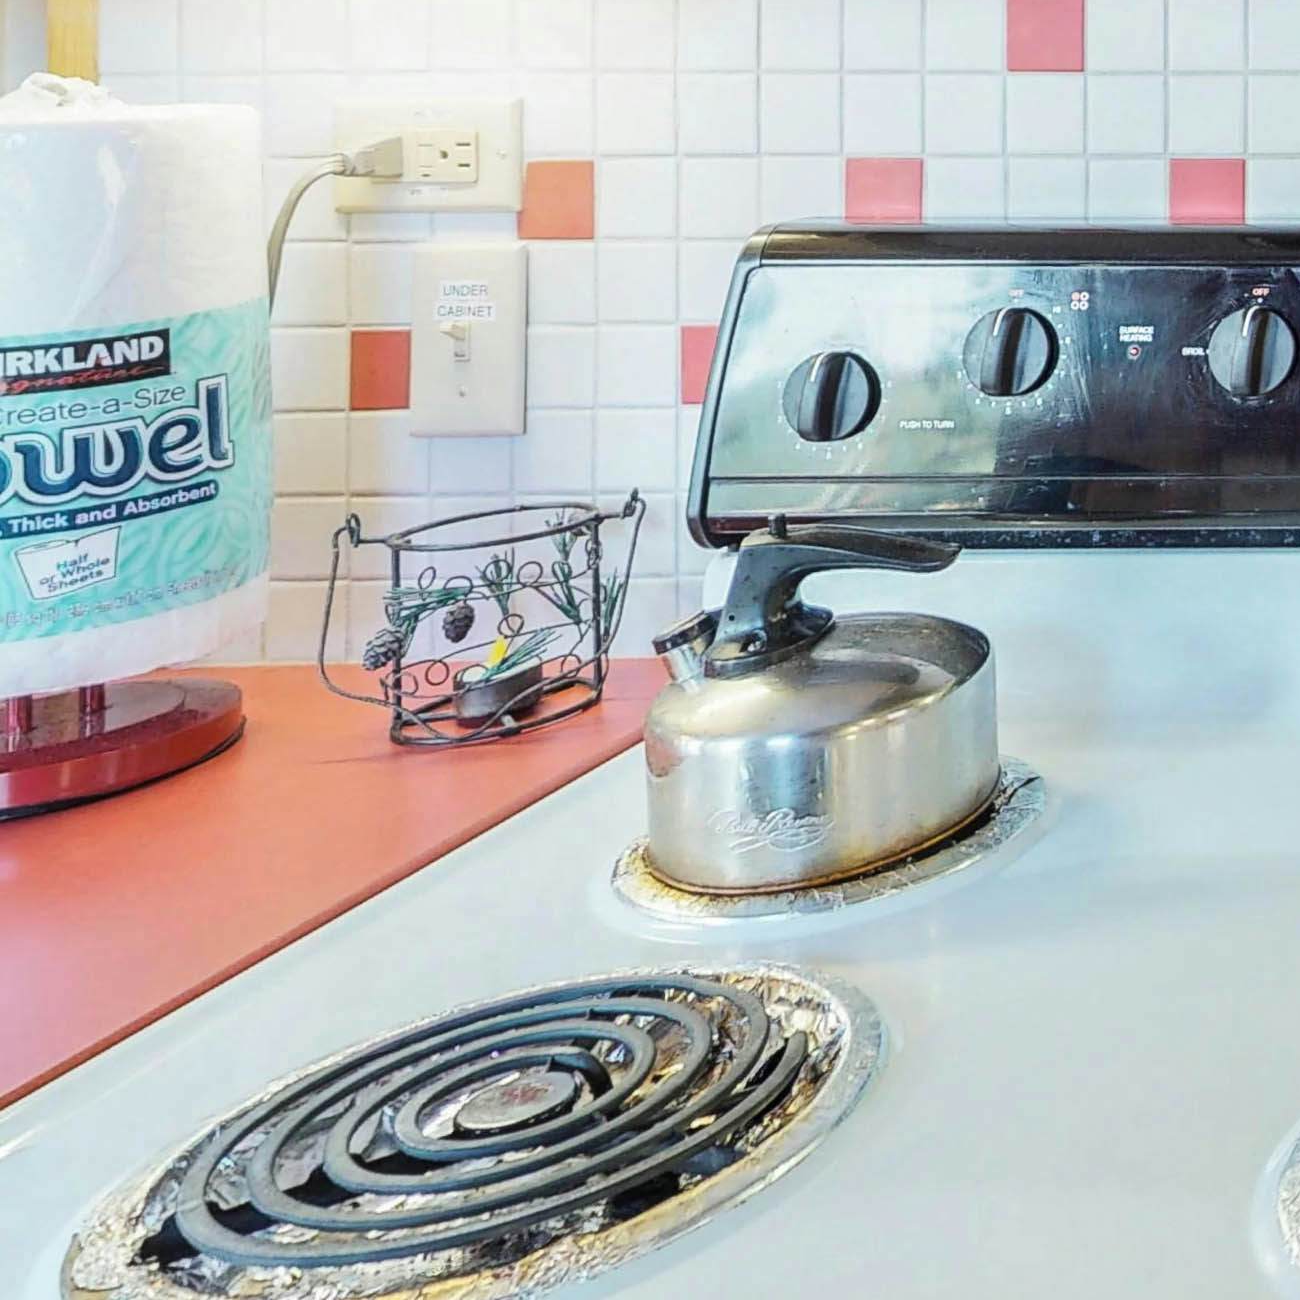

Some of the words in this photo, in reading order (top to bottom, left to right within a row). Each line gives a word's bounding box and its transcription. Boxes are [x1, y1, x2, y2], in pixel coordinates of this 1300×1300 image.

[443, 284, 489, 297] UNDER
[1252, 288, 1271, 296] OFF
[437, 305, 494, 318] CABINET
[1119, 326, 1154, 334] SURFACE
[1119, 334, 1153, 342] HEATING
[1181, 347, 1206, 356] BROIL
[0, 385, 187, 427] reate-a-Size
[900, 419, 921, 429] PUSH
[922, 419, 933, 429] TO
[934, 419, 955, 429] TURN
[8, 511, 68, 534] Thick
[75, 505, 117, 525] and
[123, 482, 218, 516] Absorbent
[57, 553, 89, 570] Half
[40, 574, 56, 586] or
[60, 558, 110, 579] Whole
[47, 569, 103, 593] Sheets
